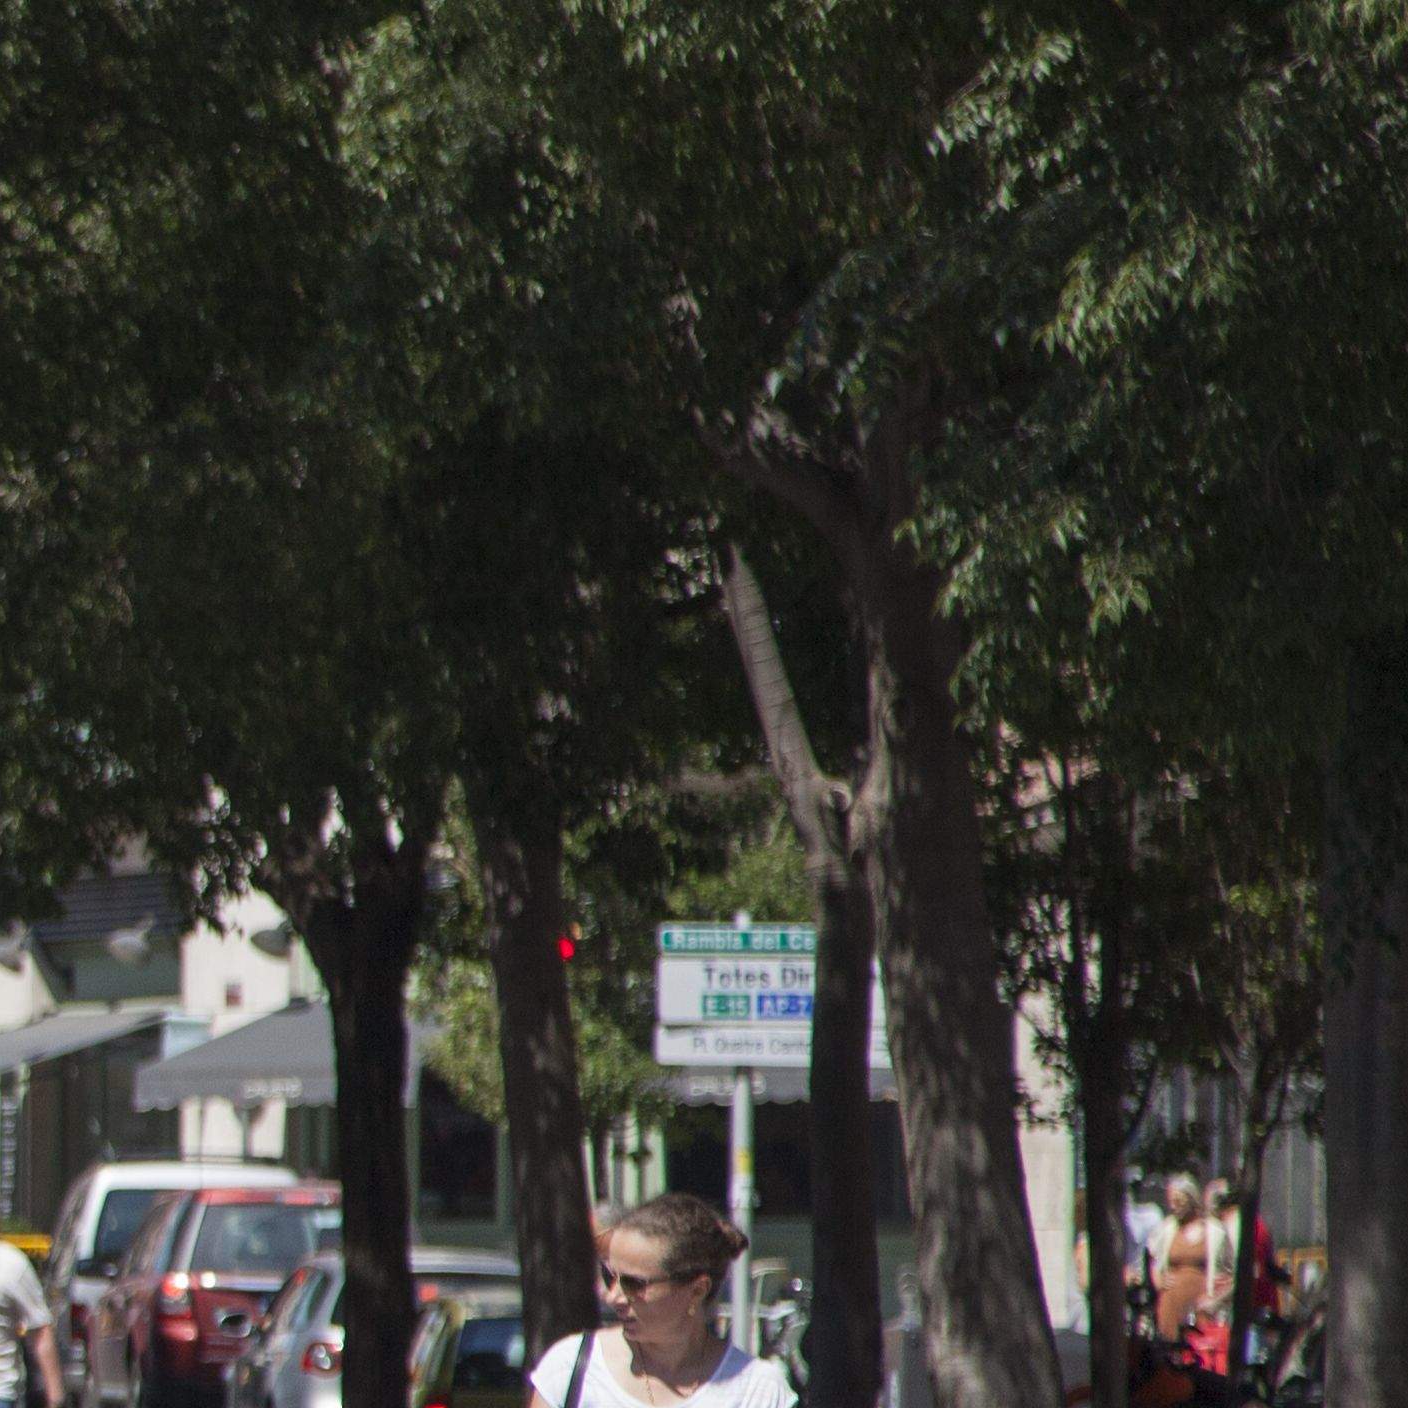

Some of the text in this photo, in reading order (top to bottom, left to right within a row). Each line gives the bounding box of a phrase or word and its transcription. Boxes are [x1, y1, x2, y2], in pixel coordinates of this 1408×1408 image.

[672, 932, 741, 949] Rambla
[751, 932, 781, 949] del
[703, 967, 771, 989] Totes
